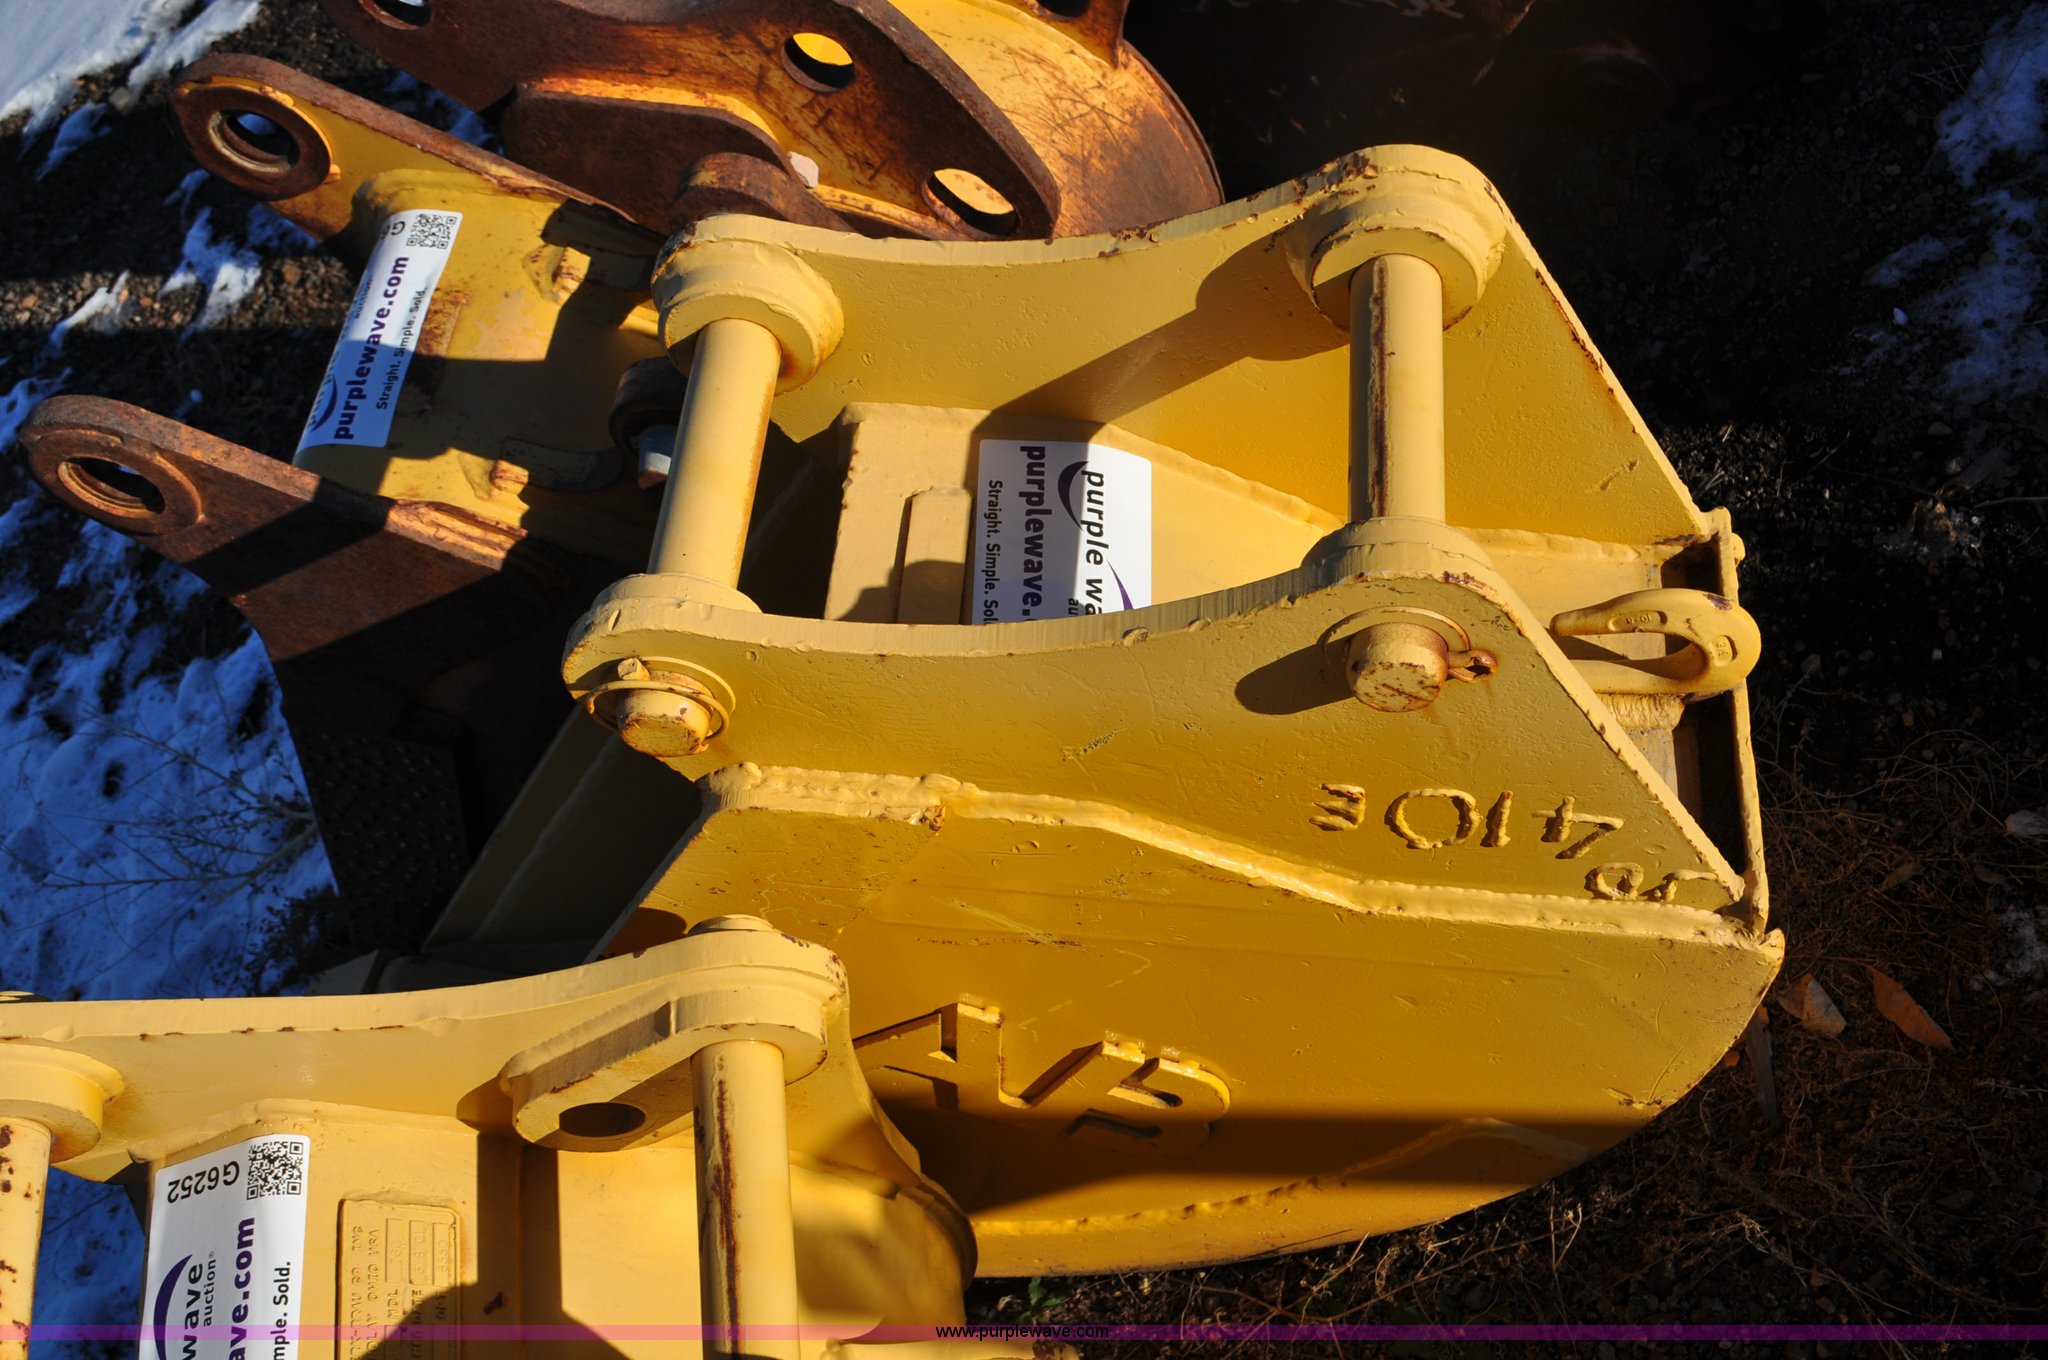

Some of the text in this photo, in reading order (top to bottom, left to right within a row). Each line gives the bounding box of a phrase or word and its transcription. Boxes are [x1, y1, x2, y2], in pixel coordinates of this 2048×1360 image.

[333, 256, 409, 440] purplewave.com
[376, 287, 428, 410] Straight. Simple. Sold.
[981, 479, 1003, 625] Straight. Simple. Sol
[1018, 446, 1052, 621] purplewave.
[1080, 470, 1109, 566] purple
[167, 1160, 240, 1204] G6252
[182, 1263, 203, 1360] wave
[273, 1261, 291, 1307] Sold.
